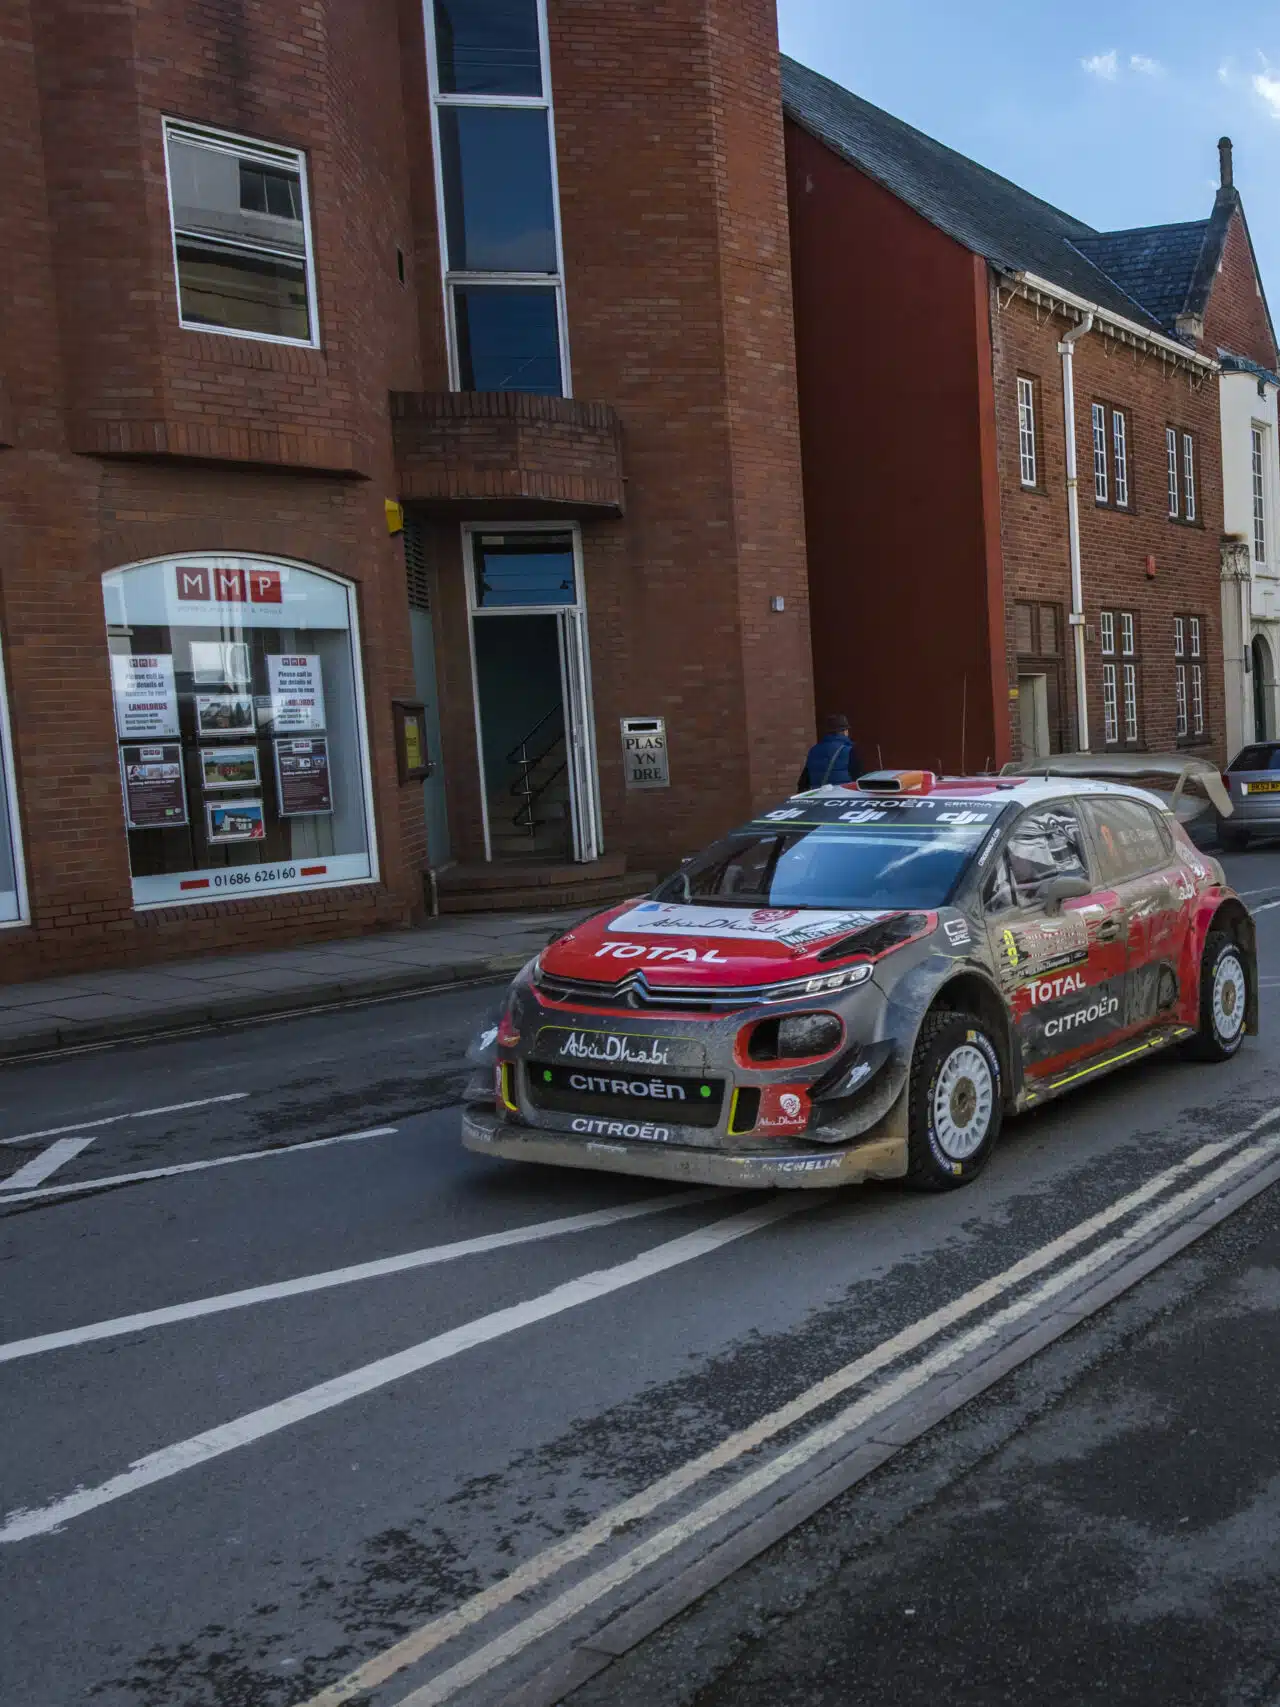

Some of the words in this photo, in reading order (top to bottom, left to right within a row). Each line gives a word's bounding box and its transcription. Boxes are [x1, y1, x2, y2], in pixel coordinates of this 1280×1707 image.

[128, 702, 168, 711] LANDLORDS
[625, 737, 664, 750] PLAS
[634, 752, 657, 765] YN
[632, 767, 662, 781] DRE
[765, 807, 807, 821] dji
[838, 808, 888, 824] dji
[935, 810, 989, 825] dji
[214, 873, 251, 888] 01686
[254, 867, 296, 883] 626160
[594, 941, 728, 964] TOTAL
[1026, 971, 1087, 1005] TOTAL
